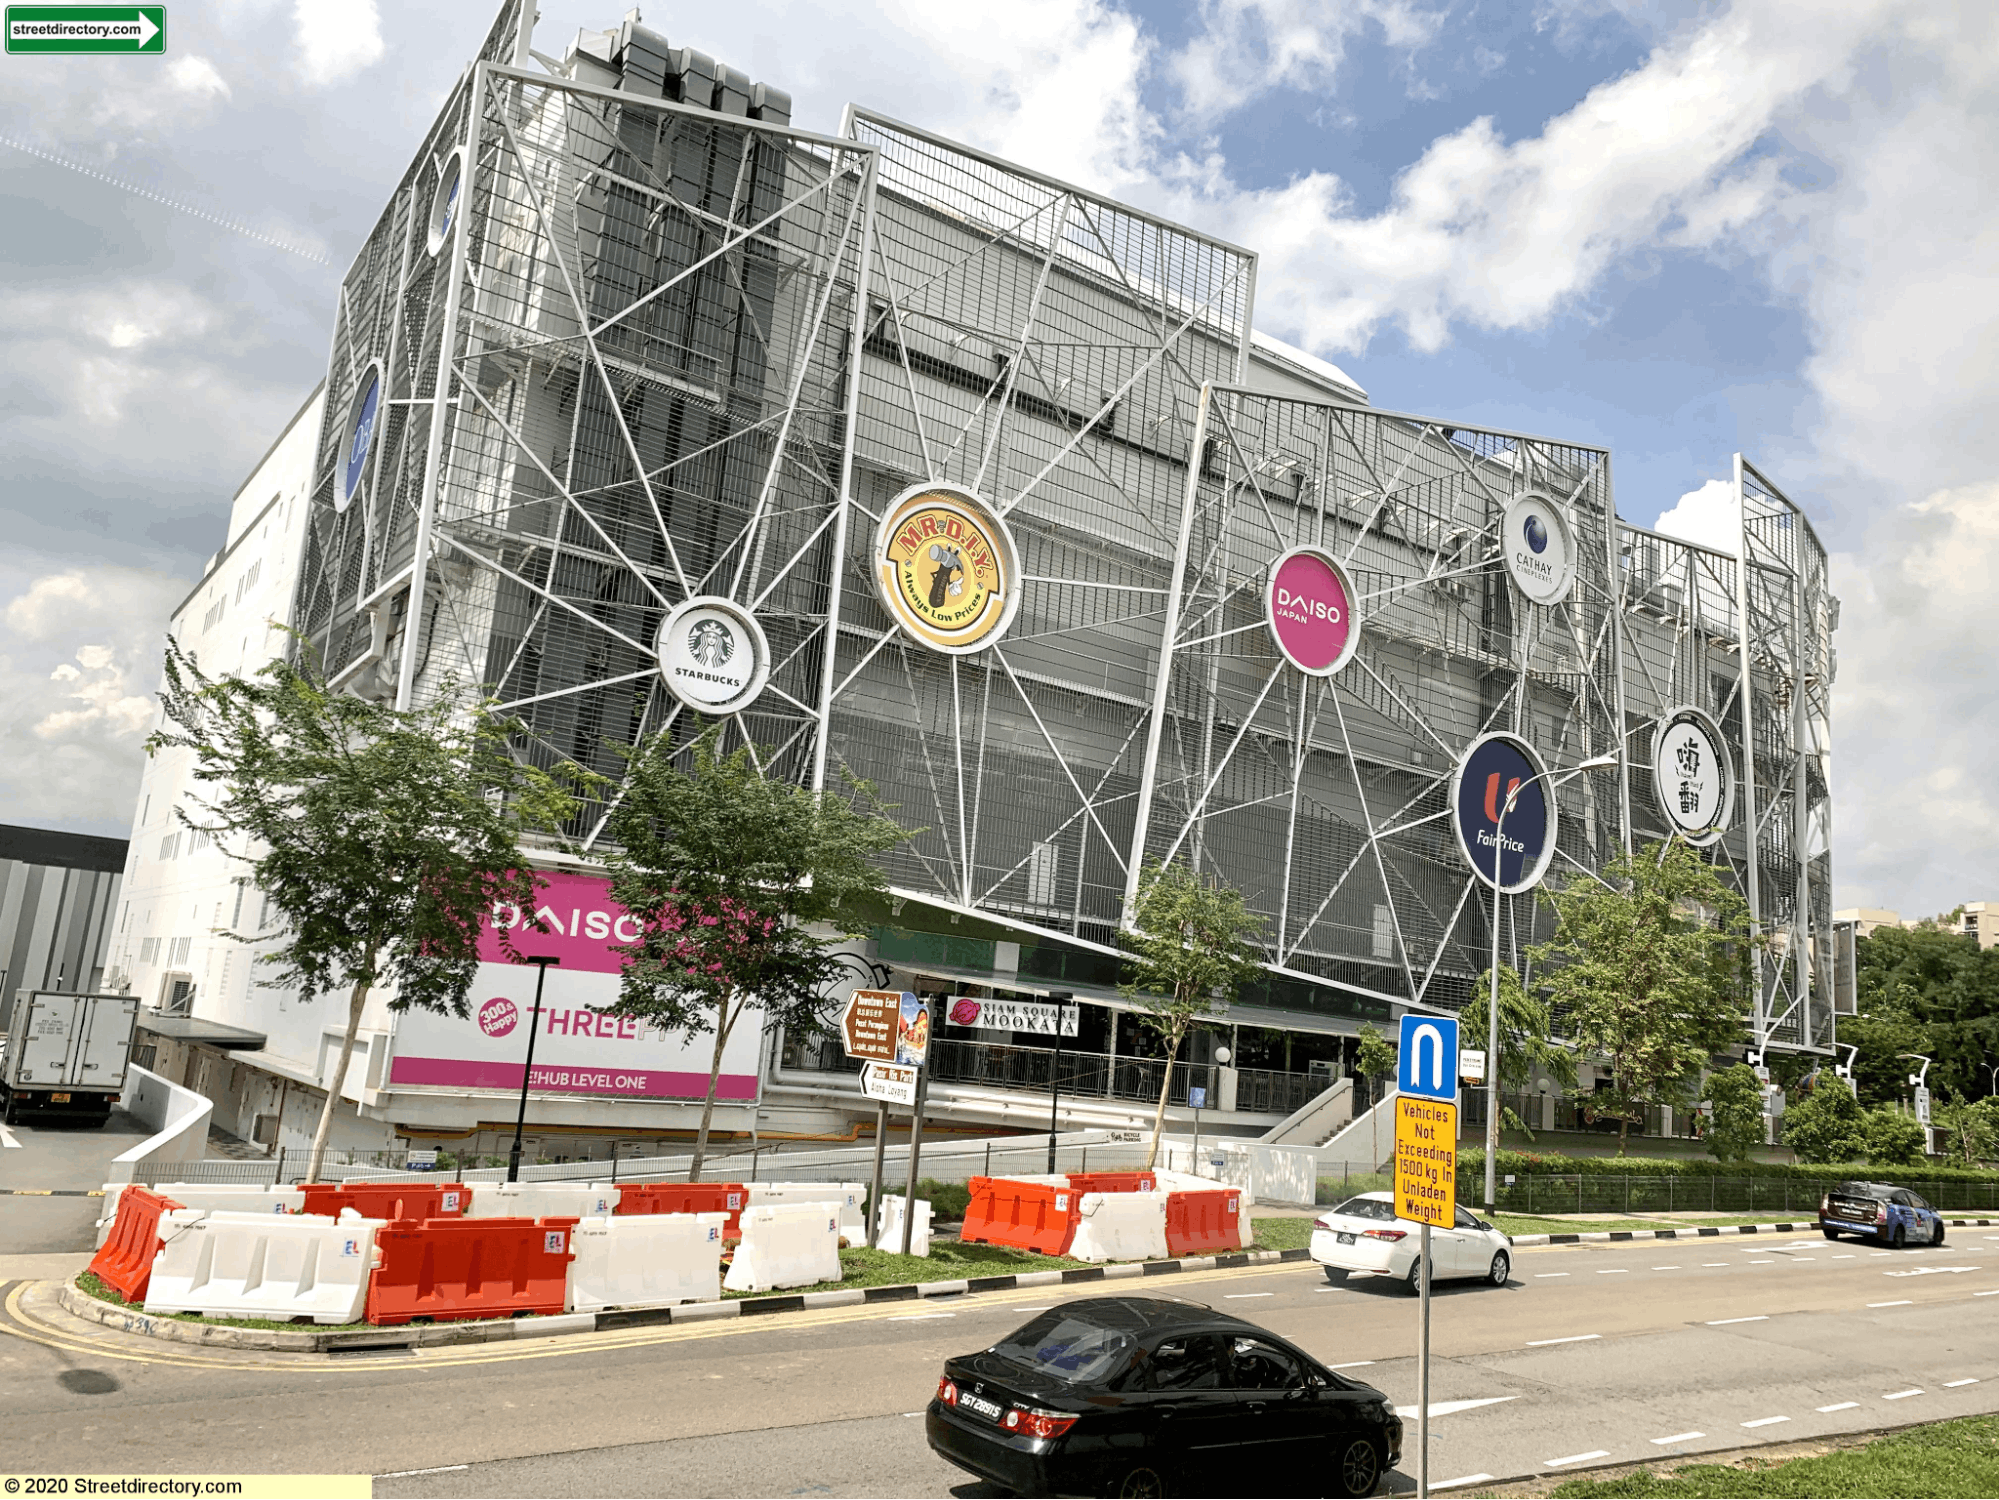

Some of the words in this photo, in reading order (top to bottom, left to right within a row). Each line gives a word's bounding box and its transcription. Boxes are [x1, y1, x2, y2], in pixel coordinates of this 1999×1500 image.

[1516, 552, 1552, 576] CATHAY
[1516, 564, 1553, 584] CINEPLEXES
[904, 570, 929, 614] Always
[931, 609, 953, 621] Low
[954, 592, 982, 620] Prices
[1277, 588, 1340, 624] DAISO
[1276, 608, 1308, 625] JAPAN
[675, 667, 740, 687] STARBUCKS
[1476, 829, 1525, 853] FairPrice
[885, 997, 898, 1009] East
[983, 1002, 1016, 1015] SIAM
[1022, 1006, 1075, 1019] SQUARE
[483, 1010, 517, 1035] Happy
[571, 1073, 613, 1088] LEVEL
[615, 1075, 647, 1090] ONE
[900, 1070, 914, 1084] Park
[887, 1084, 907, 1100] Loyang
[1403, 1102, 1448, 1123] Vehicles
[1415, 1123, 1435, 1140] Not
[1398, 1139, 1452, 1167] Exceeding
[1399, 1158, 1423, 1177] 1500
[1425, 1163, 1437, 1184] kg
[1443, 1166, 1452, 1183] In
[1402, 1178, 1446, 1202] Unladen
[1406, 1198, 1442, 1222] Weight
